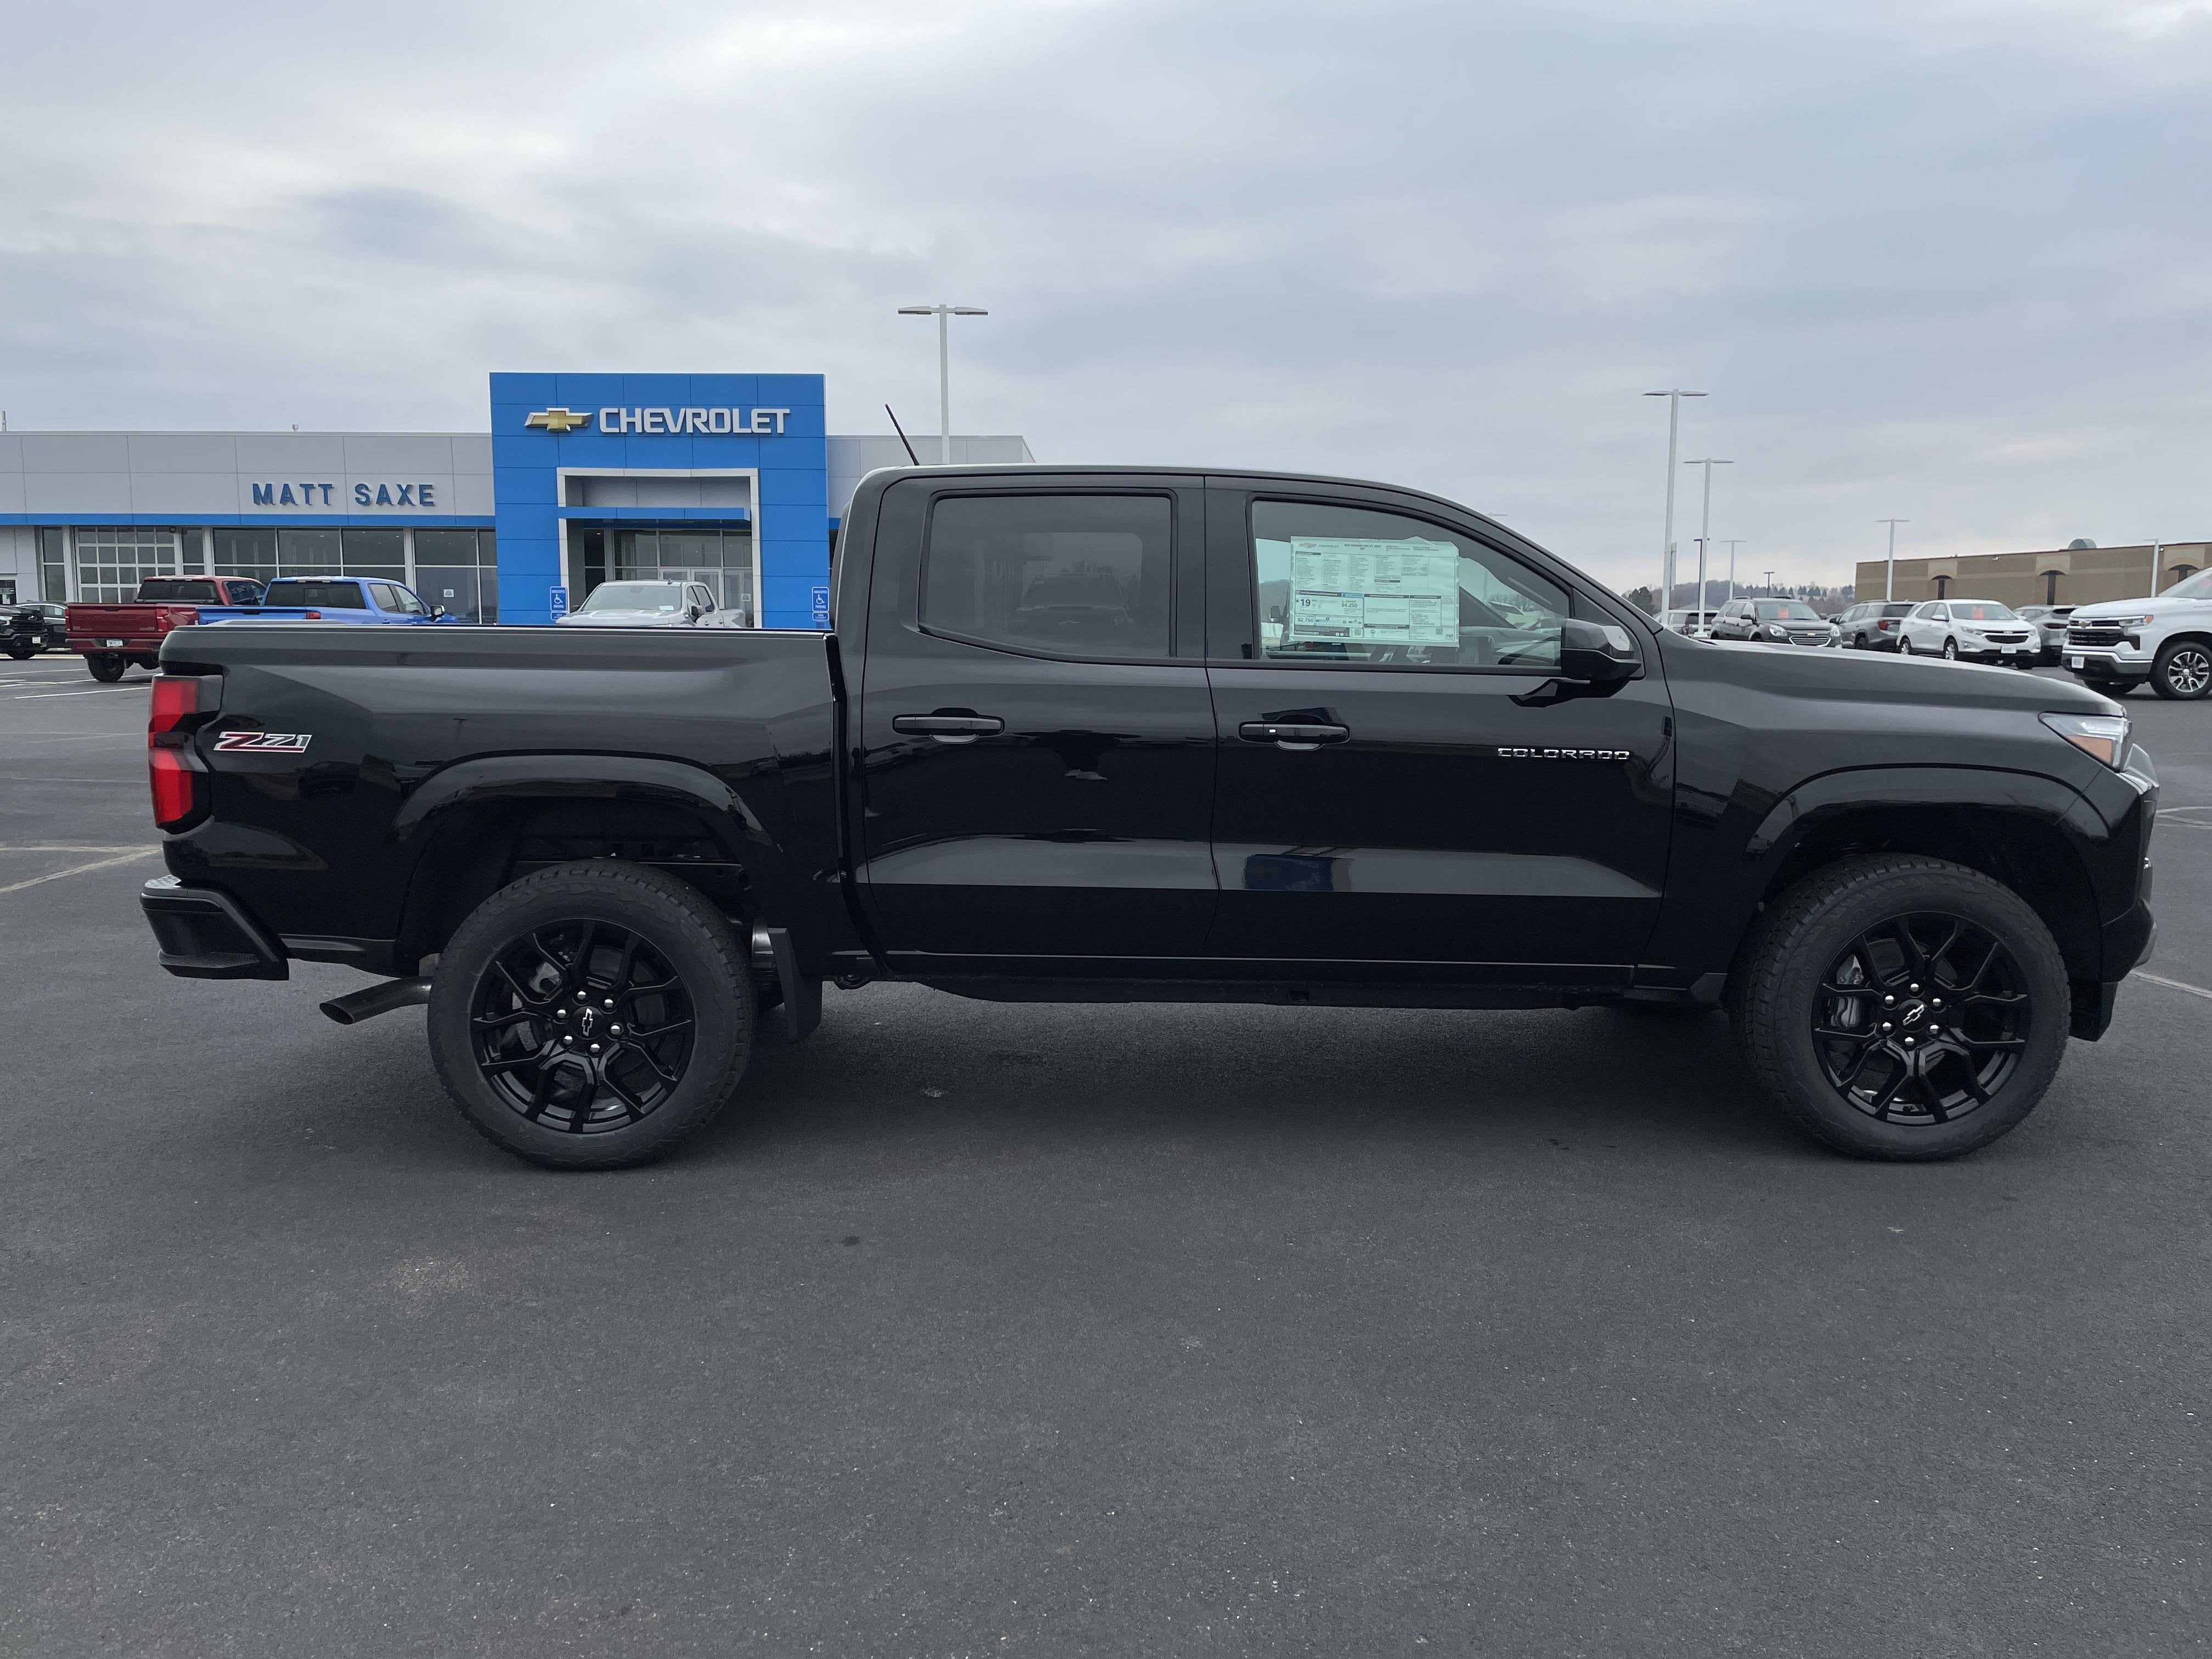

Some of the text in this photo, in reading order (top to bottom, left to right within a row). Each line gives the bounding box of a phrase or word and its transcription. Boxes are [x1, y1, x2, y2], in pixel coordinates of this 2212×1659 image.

[599, 408, 791, 435] CHEVROLET
[252, 483, 436, 506] MATT SAXE
[1300, 599, 1311, 607] 19
[213, 731, 312, 753] Z71
[1498, 748, 1630, 760] COLORADO
